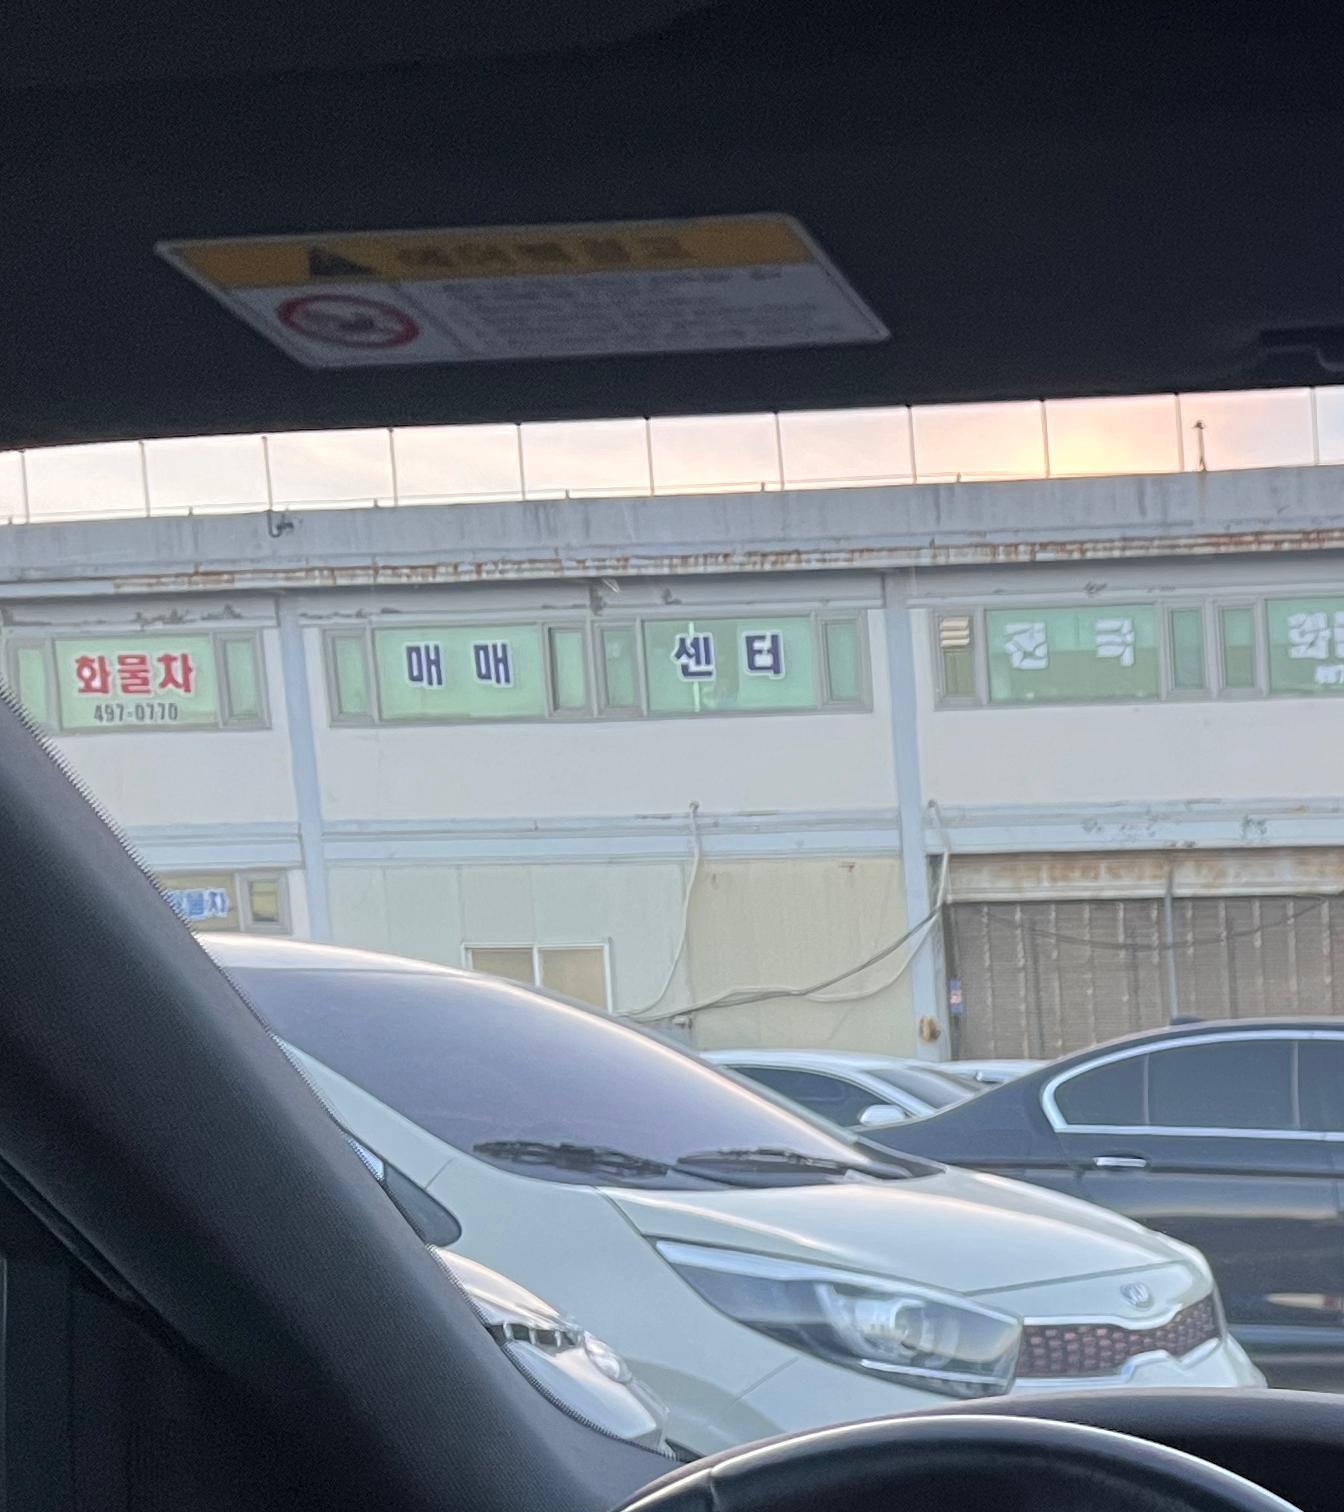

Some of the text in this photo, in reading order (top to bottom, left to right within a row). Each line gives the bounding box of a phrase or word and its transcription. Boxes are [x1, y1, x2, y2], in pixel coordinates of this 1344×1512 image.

[75, 653, 194, 694] 화물차
[405, 632, 783, 687] 매매 센터
[94, 702, 179, 722] 497-0770
